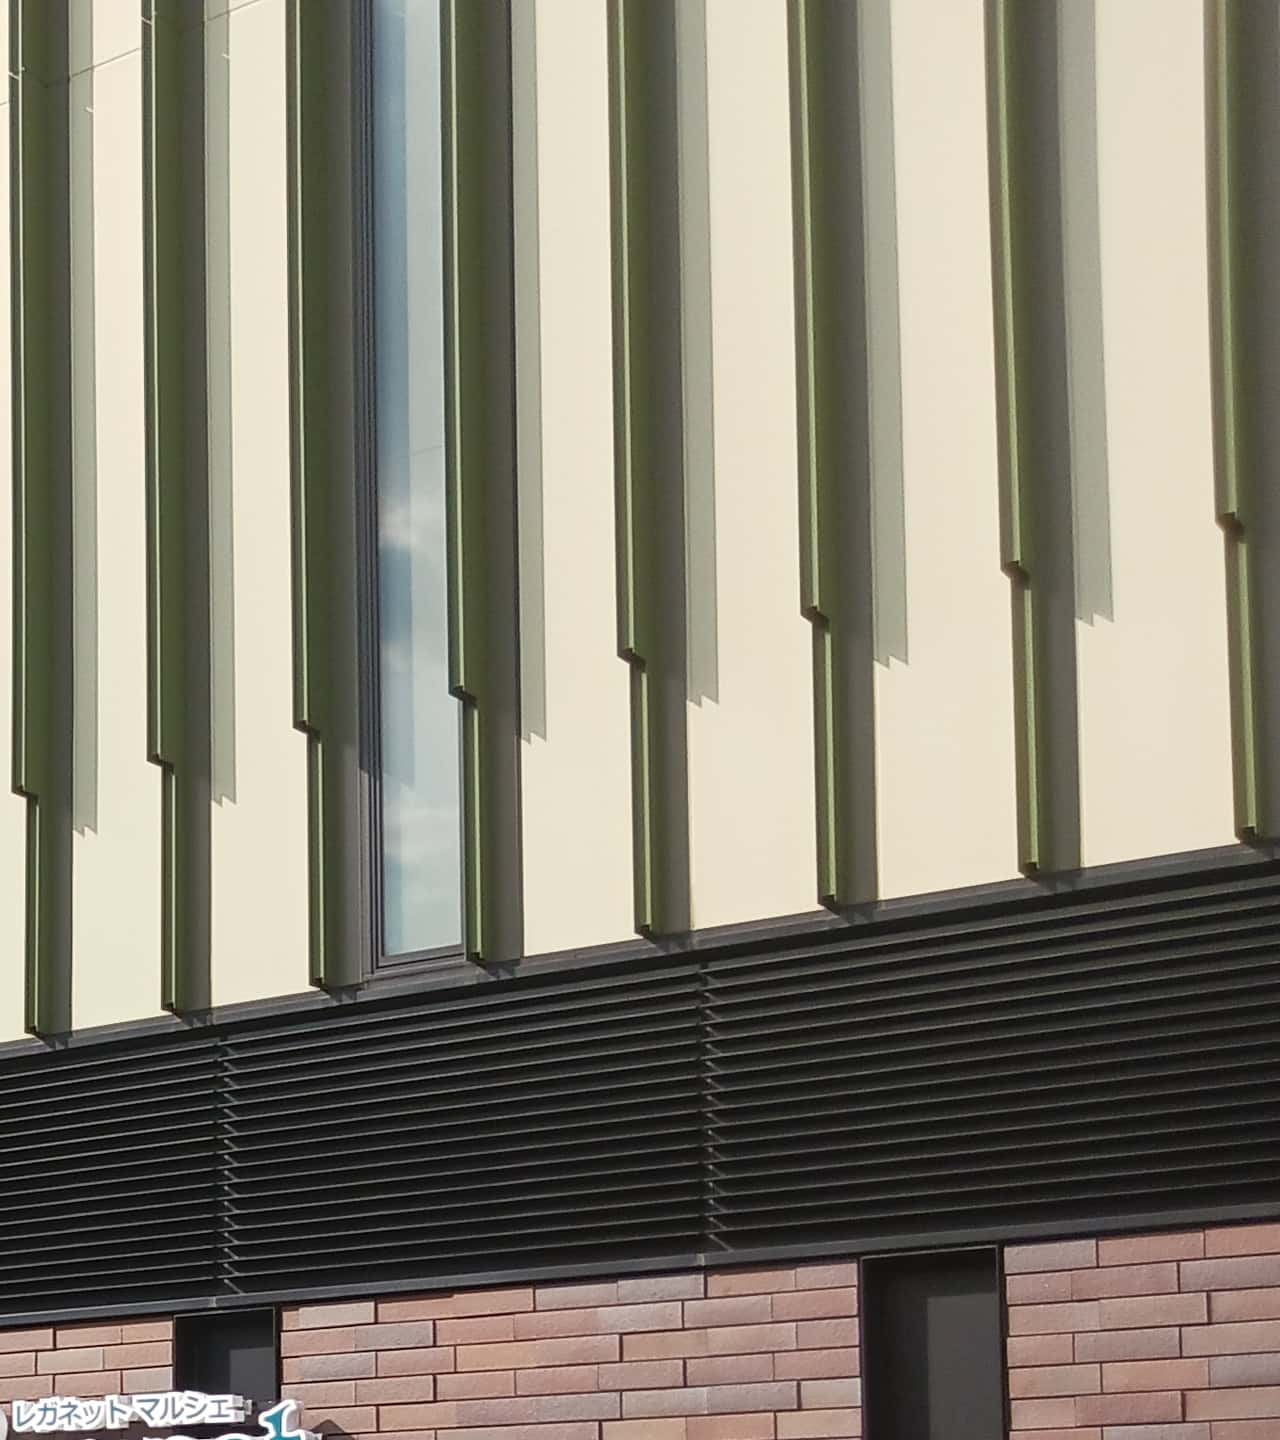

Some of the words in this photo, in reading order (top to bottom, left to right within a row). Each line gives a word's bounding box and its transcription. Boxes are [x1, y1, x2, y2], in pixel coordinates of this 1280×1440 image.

[15, 1400, 128, 1429] レガネット
[141, 1395, 235, 1422] マルシェ
